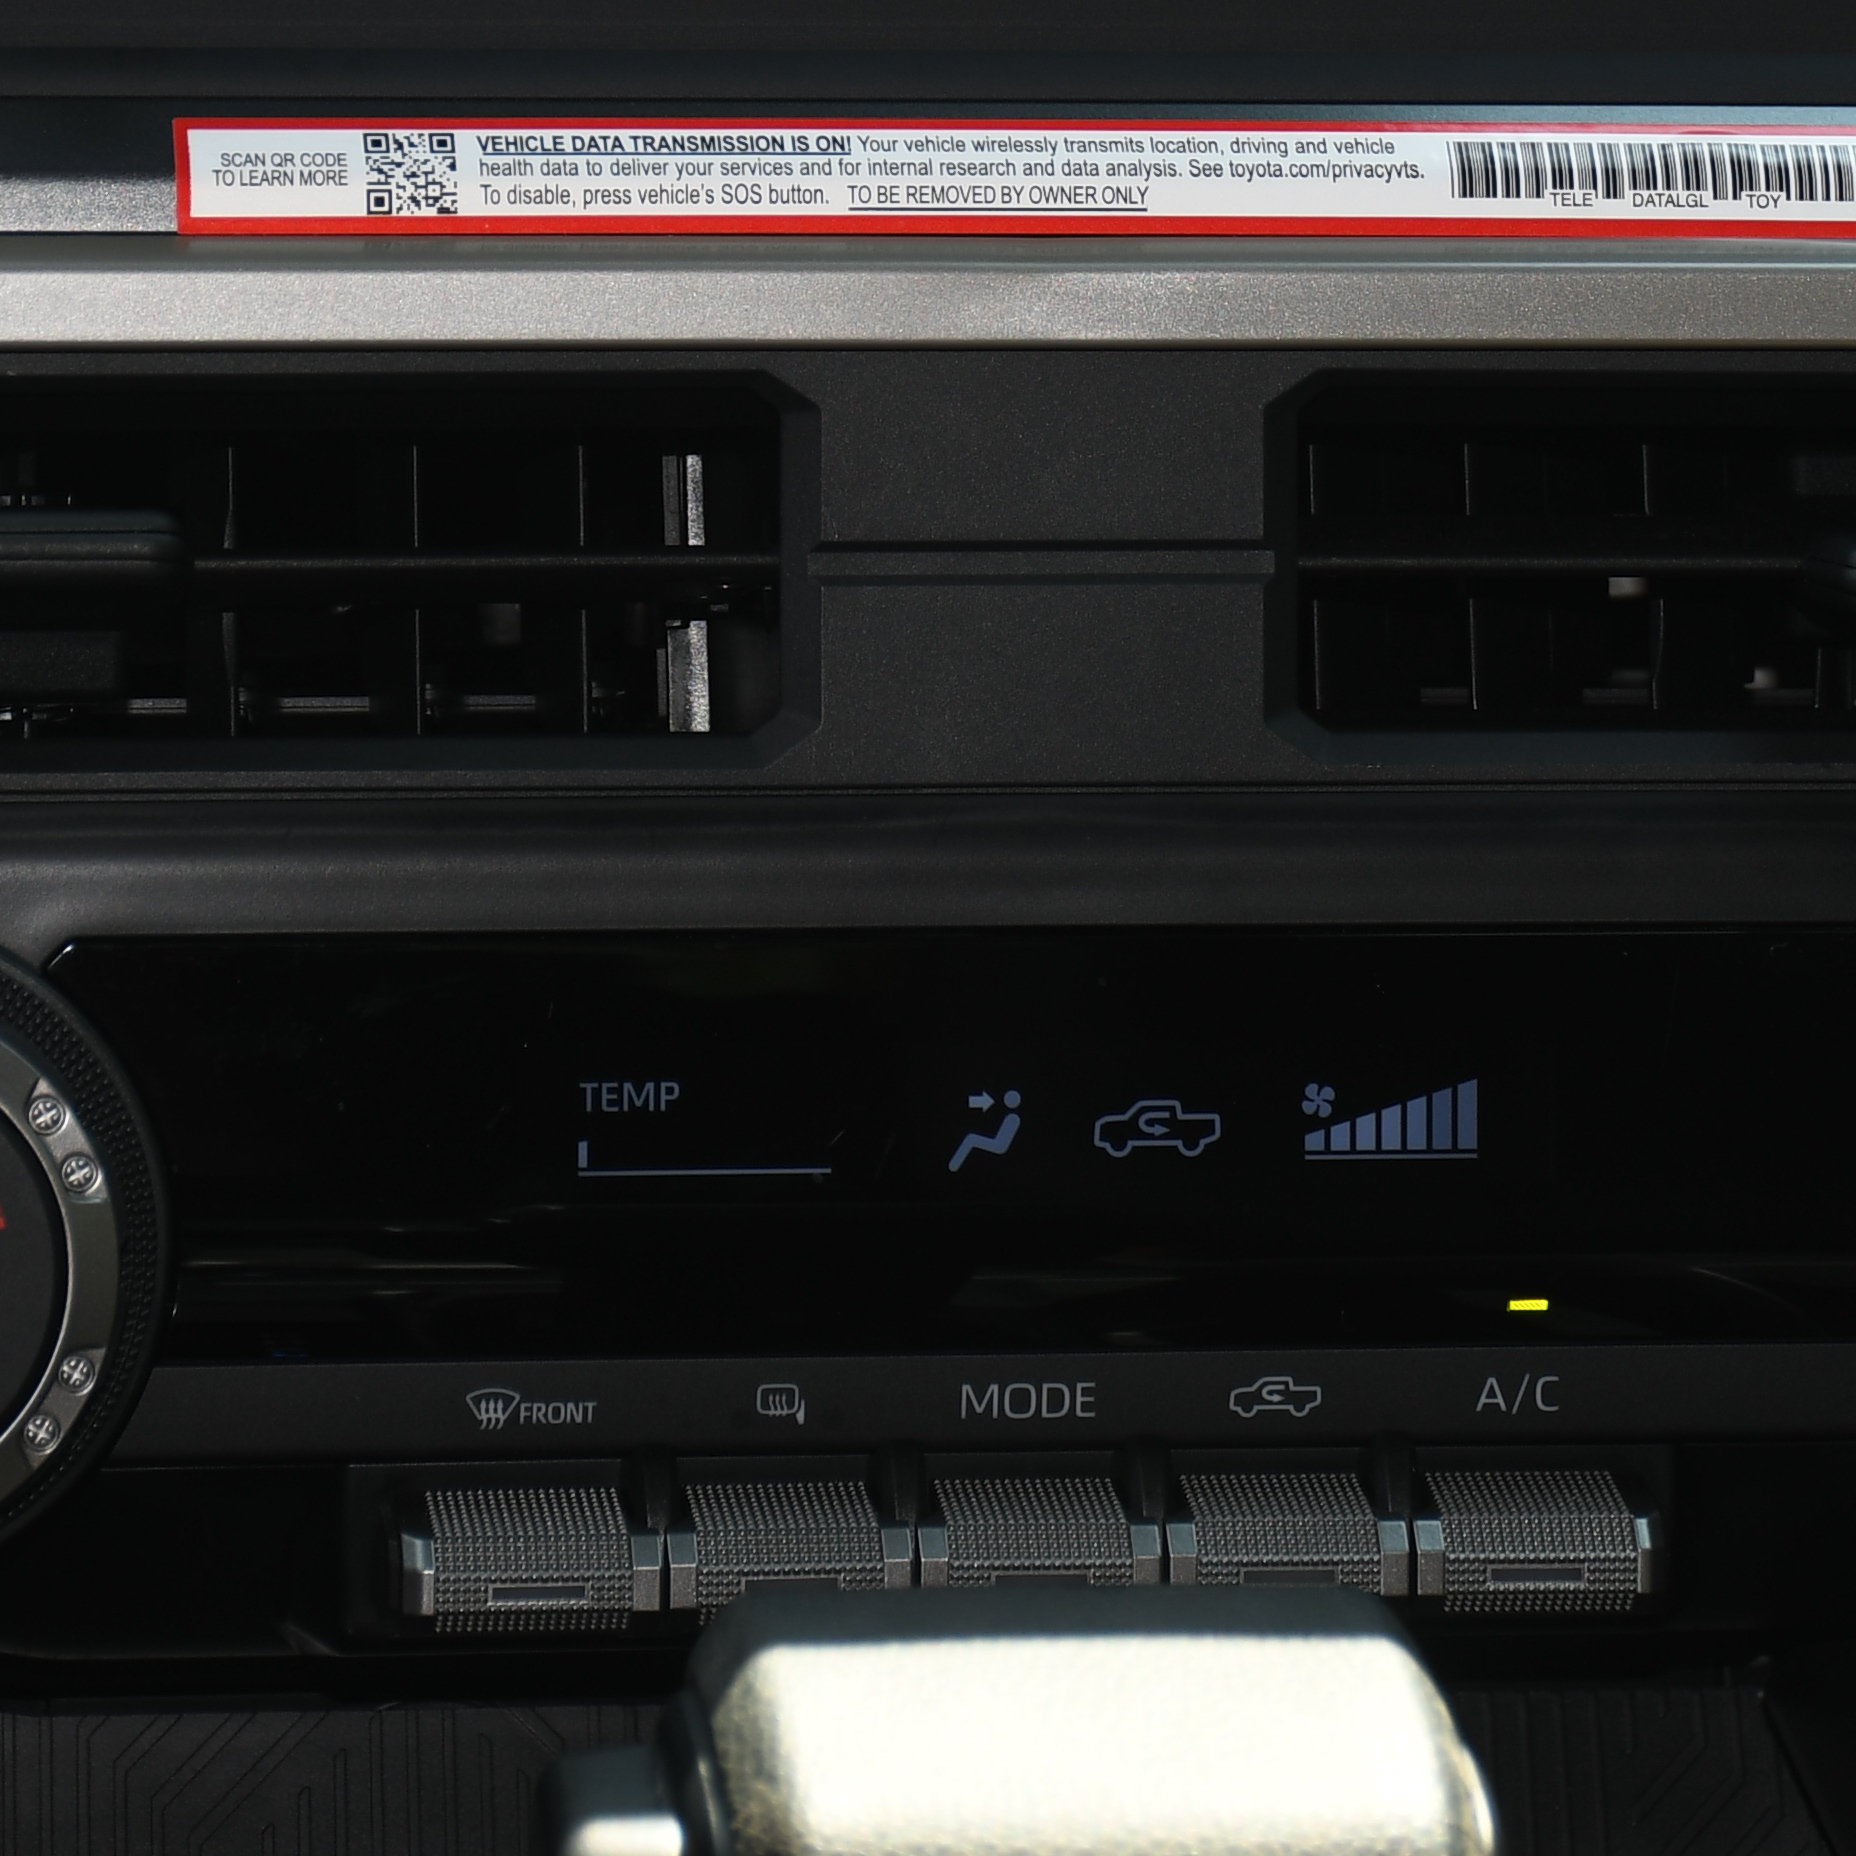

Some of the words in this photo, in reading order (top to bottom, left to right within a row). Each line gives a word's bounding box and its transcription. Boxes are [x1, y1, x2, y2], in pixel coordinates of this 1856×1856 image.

[476, 136, 565, 152] VEHICLE
[572, 136, 625, 152] DATA
[629, 136, 785, 152] TRANSMISSION
[791, 136, 809, 152] IS
[816, 136, 851, 152] ON!
[857, 136, 896, 152] Your
[903, 136, 966, 153] vehicle
[971, 136, 1058, 156] wirelessly
[1064, 137, 1144, 153] transmits
[1150, 137, 1224, 156] location,
[1230, 137, 1288, 157] driving
[1295, 137, 1327, 155] and
[1334, 138, 1395, 155] vehicle
[220, 153, 265, 167] SCAN
[271, 153, 294, 168] QR
[300, 153, 347, 167] CODE
[479, 158, 534, 176] health
[540, 158, 578, 176] data
[586, 159, 603, 176] to
[609, 158, 668, 176] deliver
[675, 162, 713, 181] your
[720, 158, 793, 176] services
[799, 158, 832, 176] and
[838, 158, 861, 176] for
[867, 158, 933, 176] internal
[939, 158, 1016, 176] research
[1023, 159, 1055, 176] and
[1061, 159, 1100, 176] data
[1105, 159, 1182, 182] analysis.
[1188, 159, 1223, 177] See
[1229, 160, 1425, 183] toyota.com/privacyvts.
[212, 170, 235, 186] TO
[240, 170, 294, 186] LEARN
[299, 170, 348, 186] MORE
[480, 184, 501, 204] To
[507, 184, 576, 208] disable,
[583, 188, 632, 209] press
[637, 183, 715, 204] vehicle's
[721, 184, 762, 204] SOS
[768, 184, 829, 204] button.
[847, 185, 871, 204] TO
[876, 185, 900, 204] BE
[906, 185, 995, 204] REMOVED
[1001, 185, 1025, 204] BY
[1028, 185, 1098, 204] OWNER
[1101, 185, 1149, 204] ONLY
[1550, 193, 1593, 208] TELE
[1632, 193, 1709, 209] DATALGL
[1746, 194, 1782, 209] TOY
[579, 1080, 681, 1115] TEMP
[960, 1382, 1097, 1418] MODE
[1476, 1375, 1560, 1416] A/C
[519, 1401, 597, 1425] FRONT
